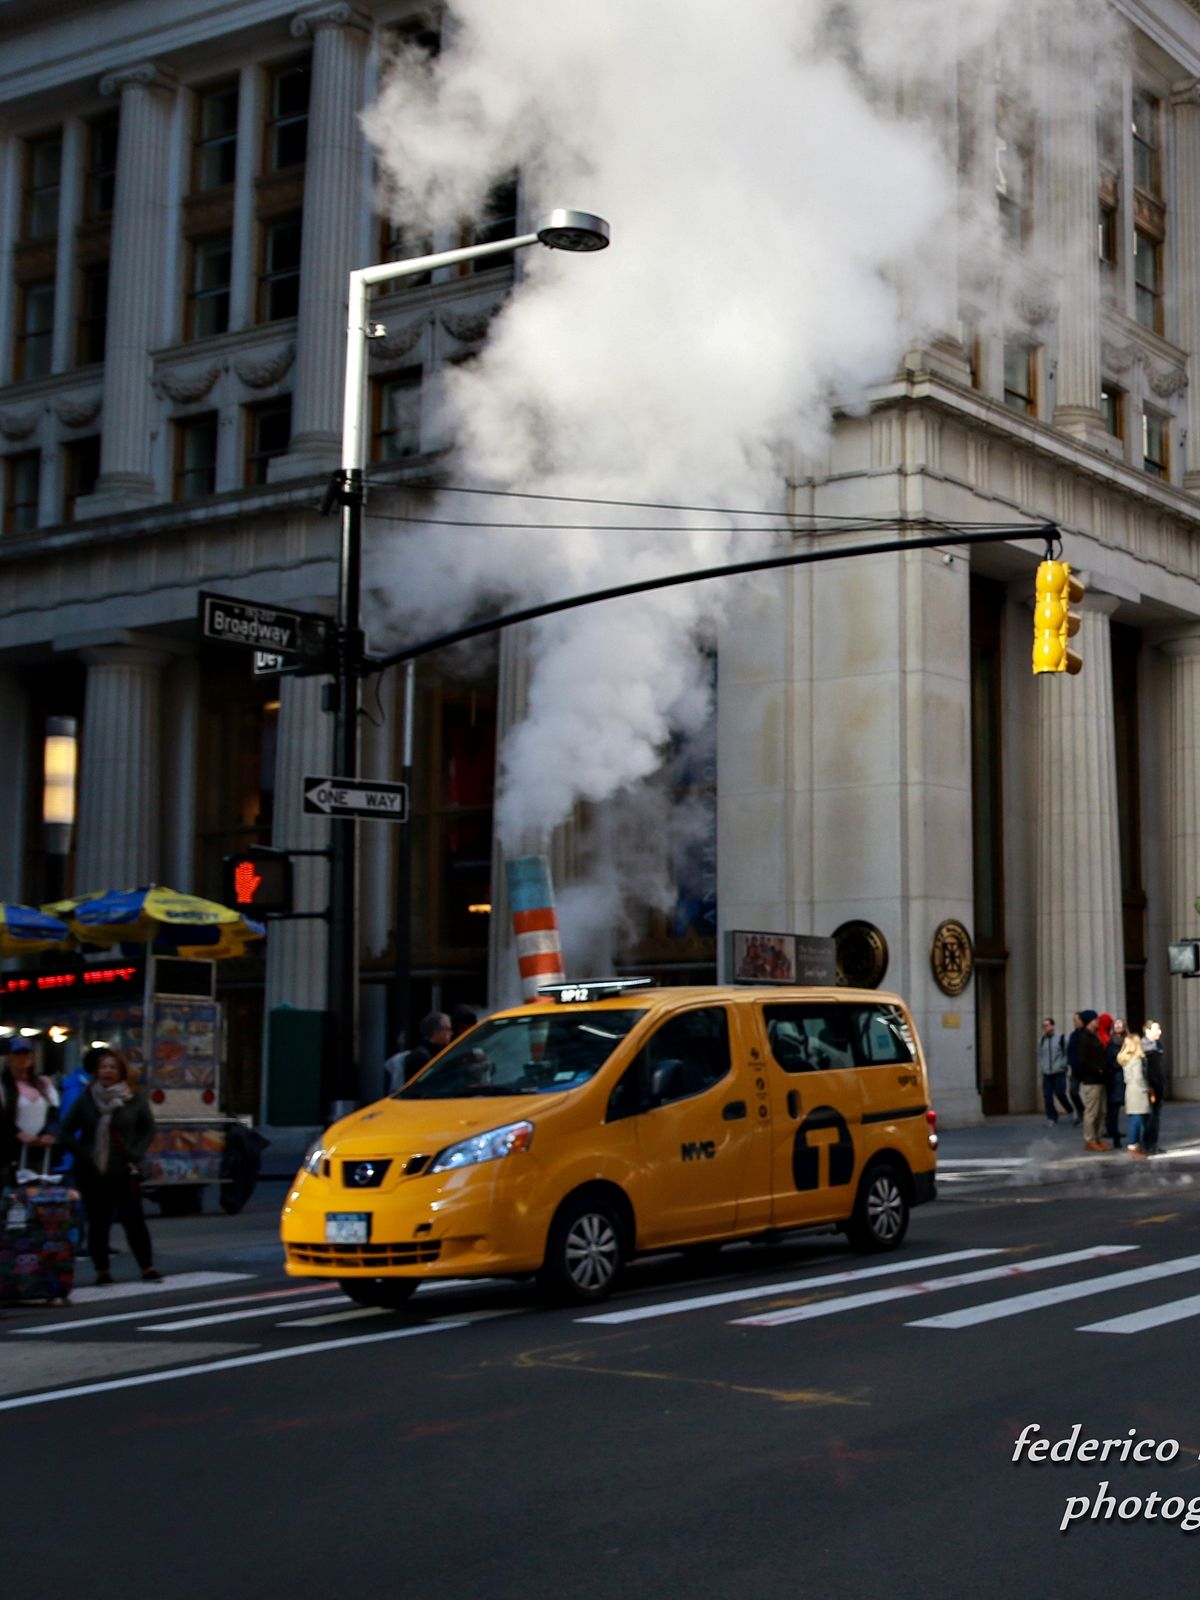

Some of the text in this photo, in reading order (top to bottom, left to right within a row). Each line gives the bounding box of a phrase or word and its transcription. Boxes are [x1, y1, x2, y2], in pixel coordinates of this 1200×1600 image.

[213, 609, 291, 647] Broadway
[317, 789, 398, 809] ONE WAY
[682, 1141, 716, 1162] NYC
